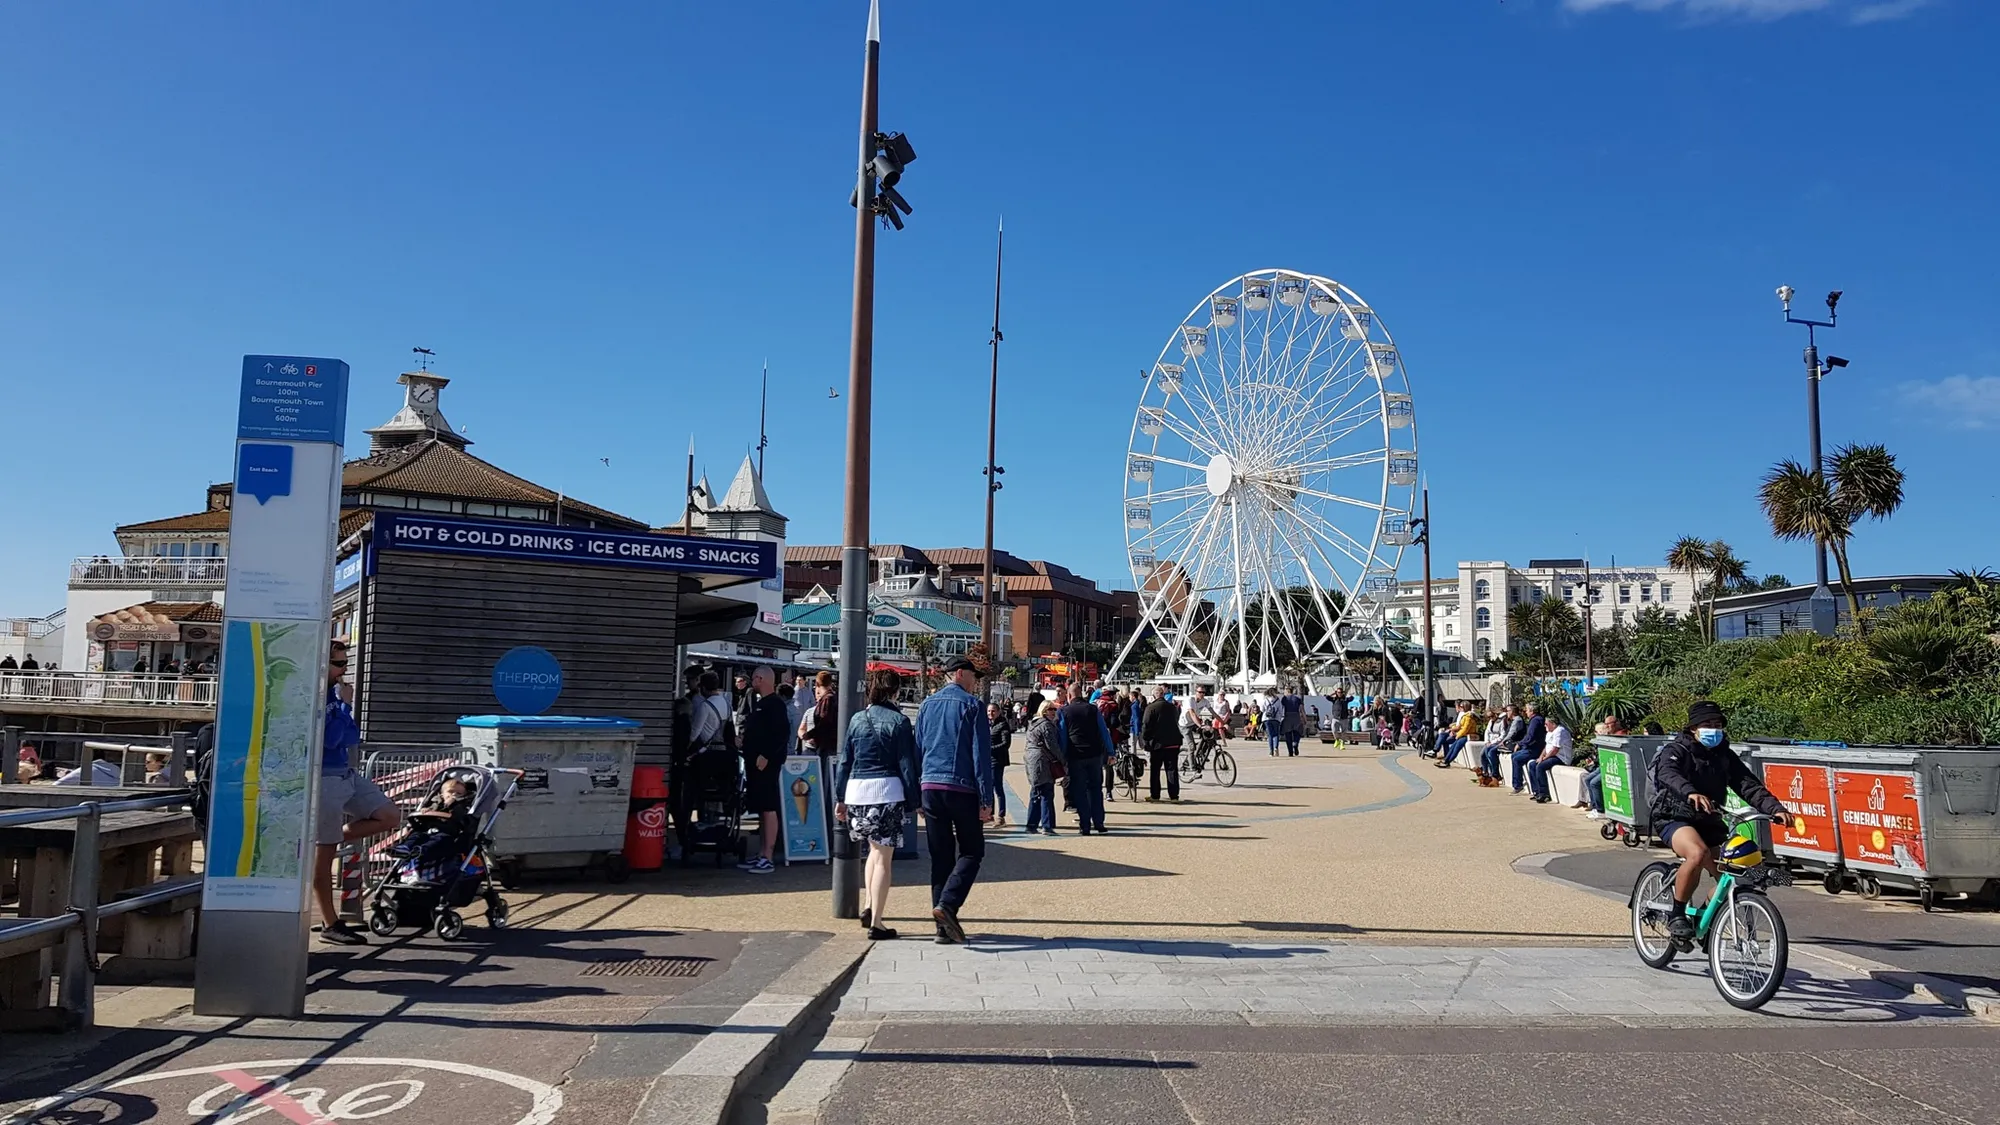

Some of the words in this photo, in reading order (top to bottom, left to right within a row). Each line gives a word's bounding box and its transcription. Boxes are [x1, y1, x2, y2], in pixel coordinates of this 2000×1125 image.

[307, 366, 314, 375] 2
[256, 379, 307, 388] Bournemouth
[308, 381, 323, 389] Pier
[278, 388, 299, 396] 100m
[251, 396, 302, 405] Bournemouth
[274, 406, 300, 414] Centre
[275, 415, 297, 423] 600m
[395, 525, 433, 540] HOT
[437, 528, 450, 541] &
[454, 530, 505, 546] COLD
[509, 534, 574, 551] DRINKS
[588, 540, 615, 554] ICE
[618, 543, 685, 559] CREAMS
[698, 549, 759, 565] SNACKS
[1801, 802, 1826, 817] WASTE
[1843, 810, 1881, 827] GENERAL
[1882, 814, 1913, 831] WASTE
